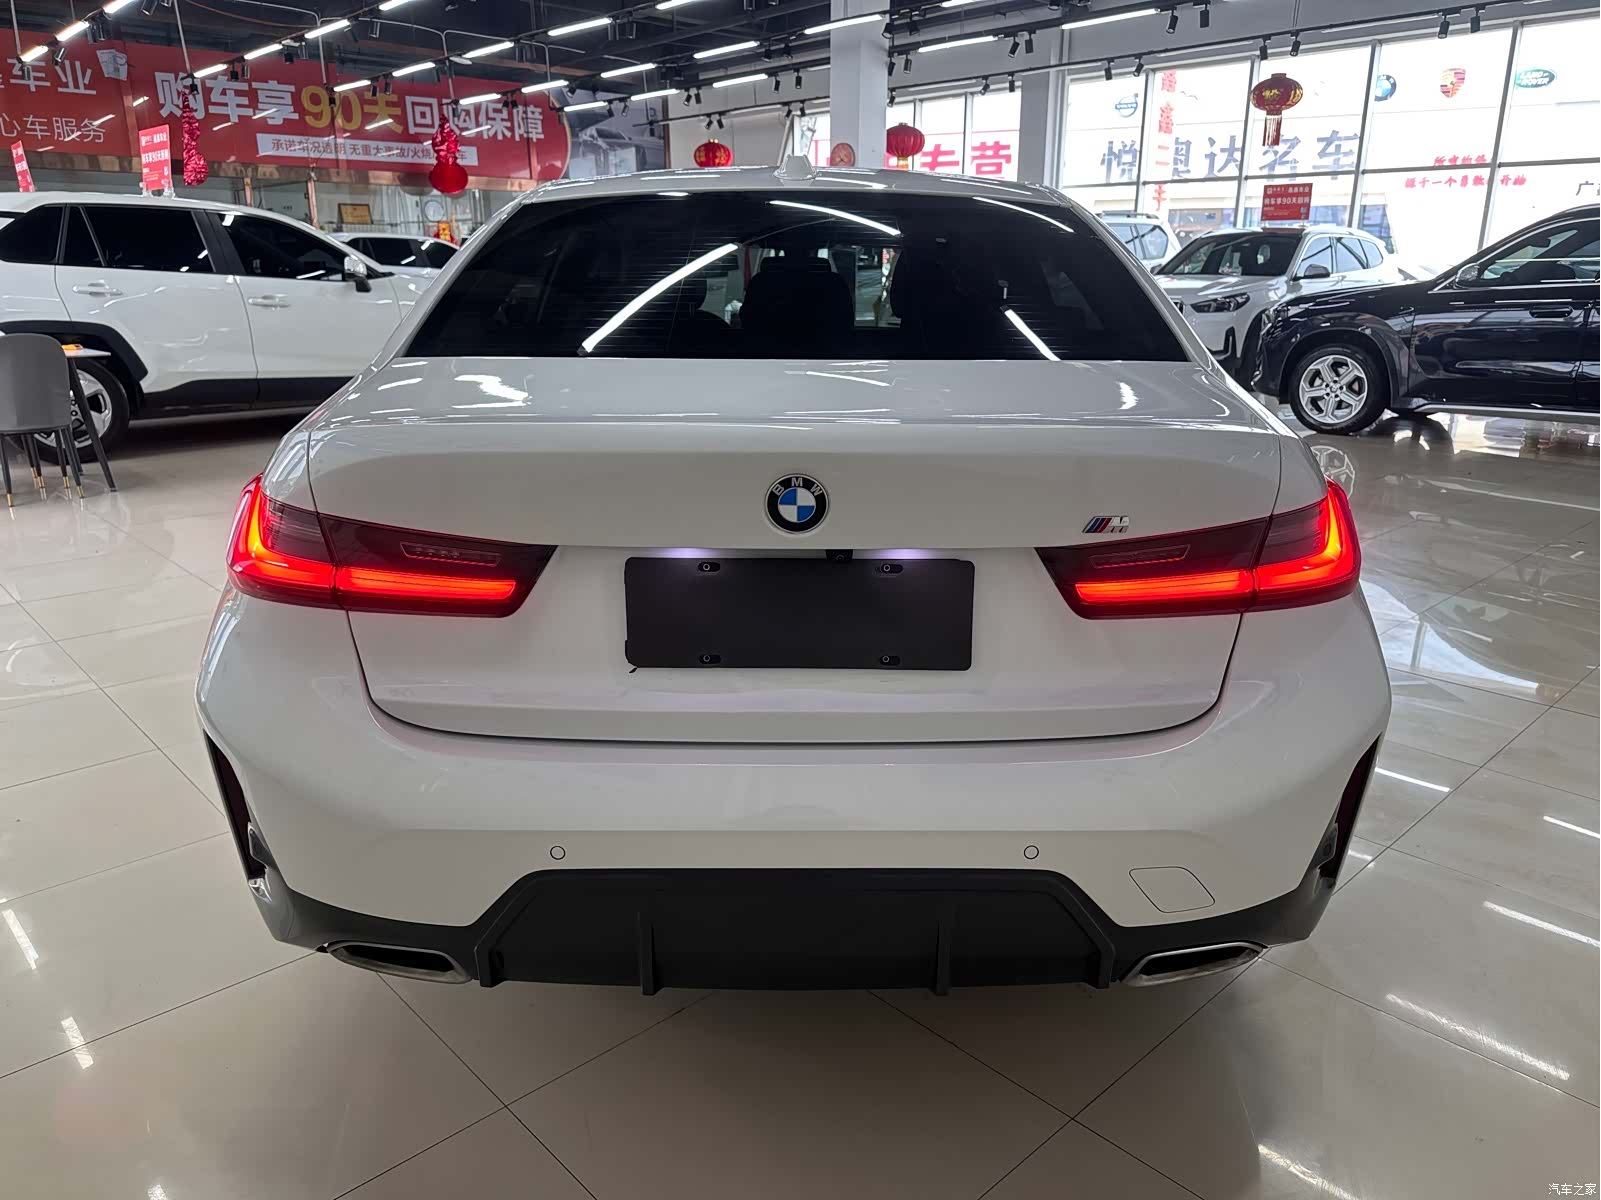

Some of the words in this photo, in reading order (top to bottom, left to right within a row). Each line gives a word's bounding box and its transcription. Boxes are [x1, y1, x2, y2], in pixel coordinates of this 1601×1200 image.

[0, 58, 97, 95] 车业
[0, 113, 106, 143] 心车服务
[771, 477, 823, 497] BMW
